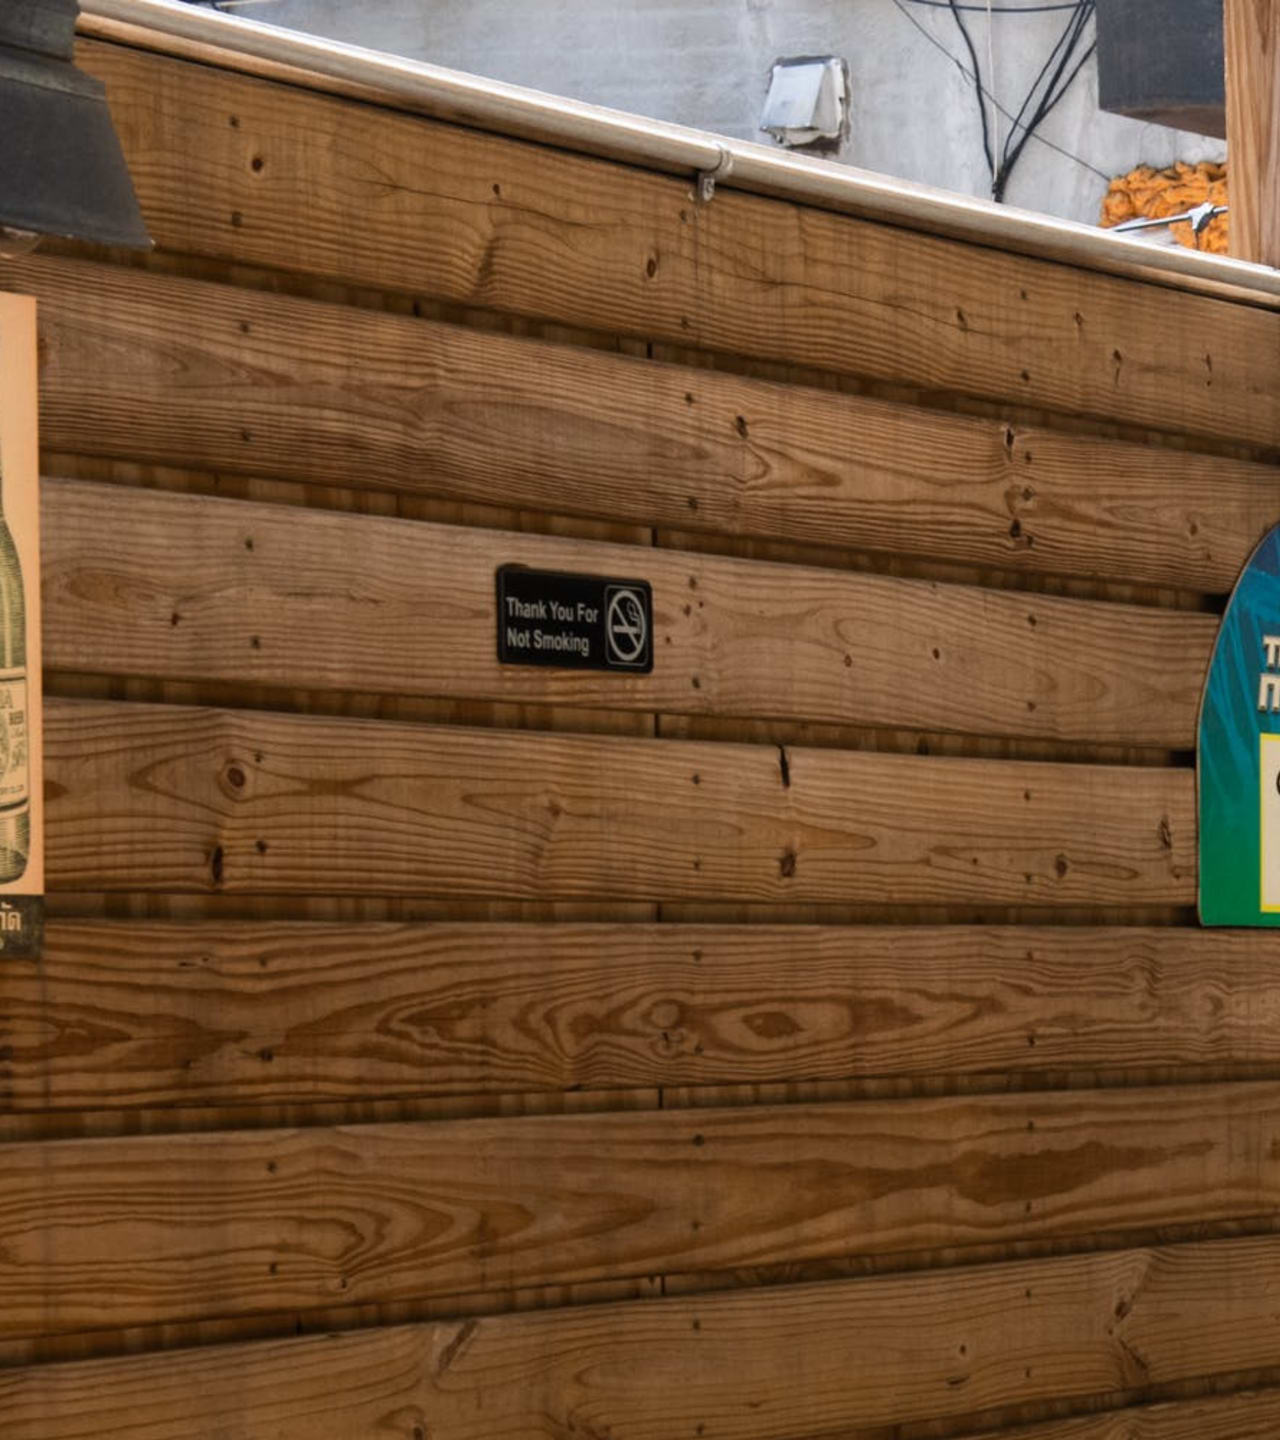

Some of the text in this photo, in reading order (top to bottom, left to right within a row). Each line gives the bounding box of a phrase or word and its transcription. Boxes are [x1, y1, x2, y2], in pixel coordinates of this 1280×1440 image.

[505, 596, 600, 624] Thank You For
[506, 628, 591, 657] Not Smoking
